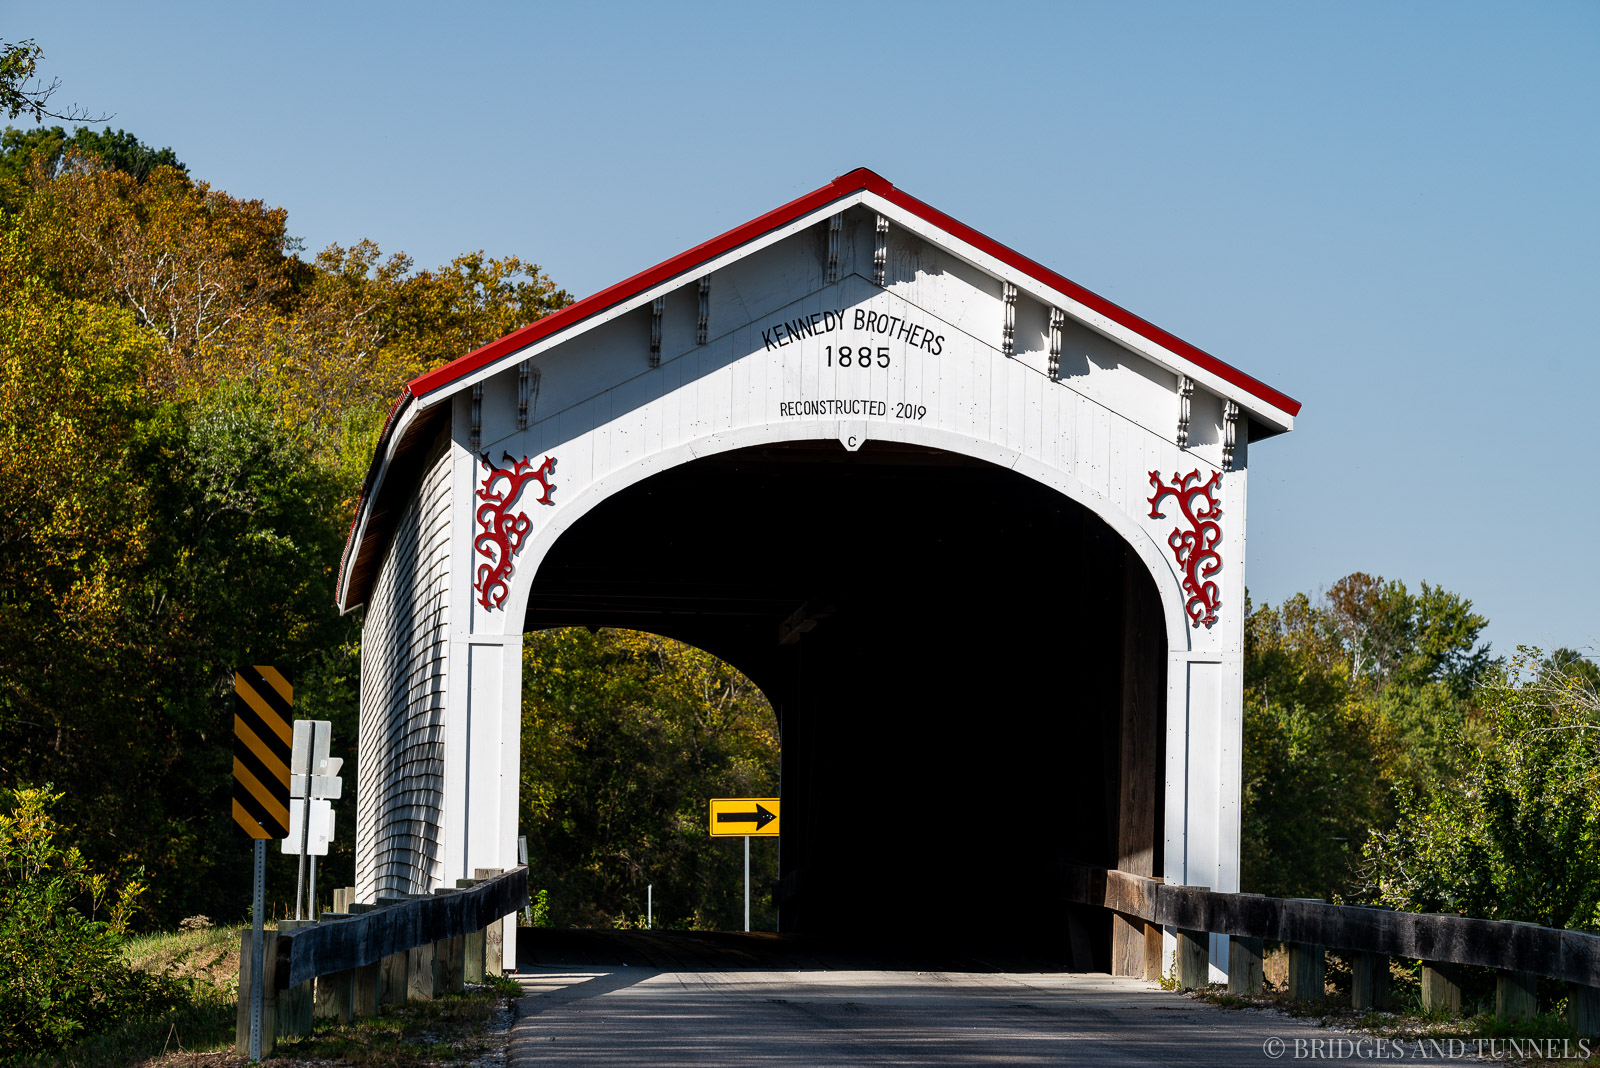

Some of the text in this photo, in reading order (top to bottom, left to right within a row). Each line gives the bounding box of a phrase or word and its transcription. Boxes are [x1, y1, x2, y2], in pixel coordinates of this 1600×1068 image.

[762, 308, 945, 356] KENNEDY BROTHERS
[825, 345, 891, 368] 1885
[780, 399, 886, 417] RECONSTRUCTED
[847, 436, 857, 448] C
